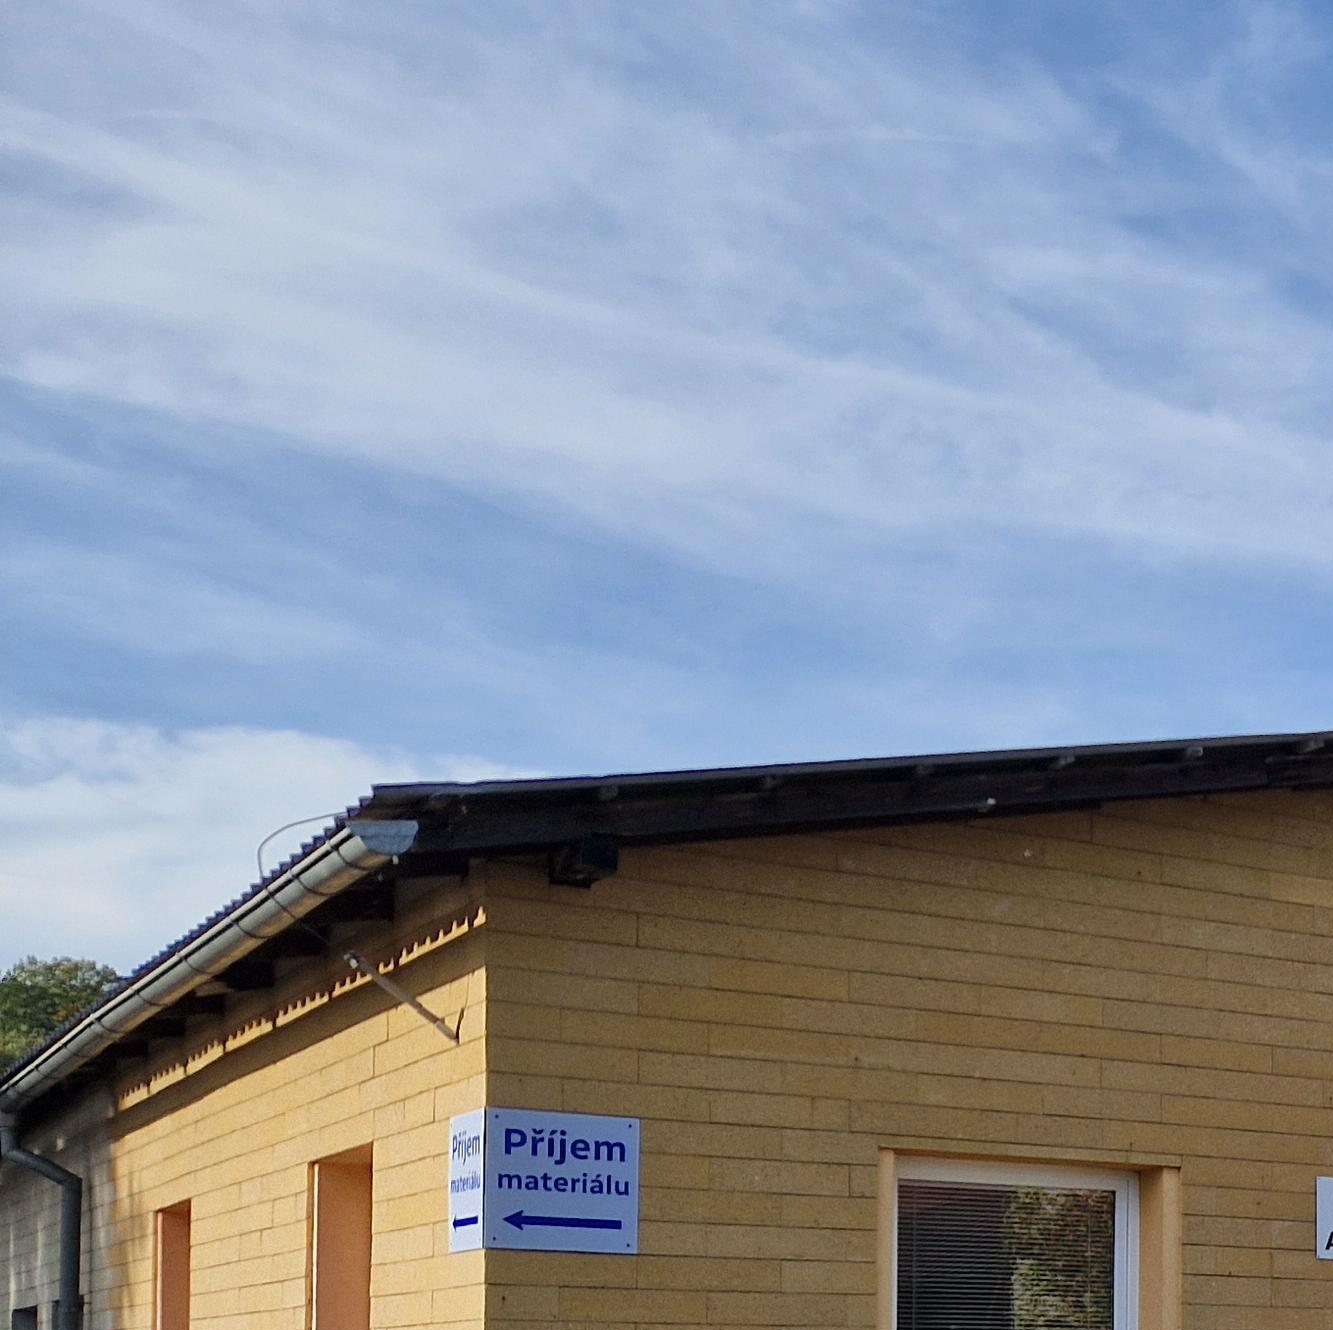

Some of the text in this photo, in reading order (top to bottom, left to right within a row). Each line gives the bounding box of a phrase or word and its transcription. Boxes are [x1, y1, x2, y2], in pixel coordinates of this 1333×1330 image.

[452, 1131, 481, 1166] Příjem
[504, 1127, 626, 1165] Příjem
[450, 1170, 481, 1193] materiálu
[497, 1172, 629, 1196] materiálu
